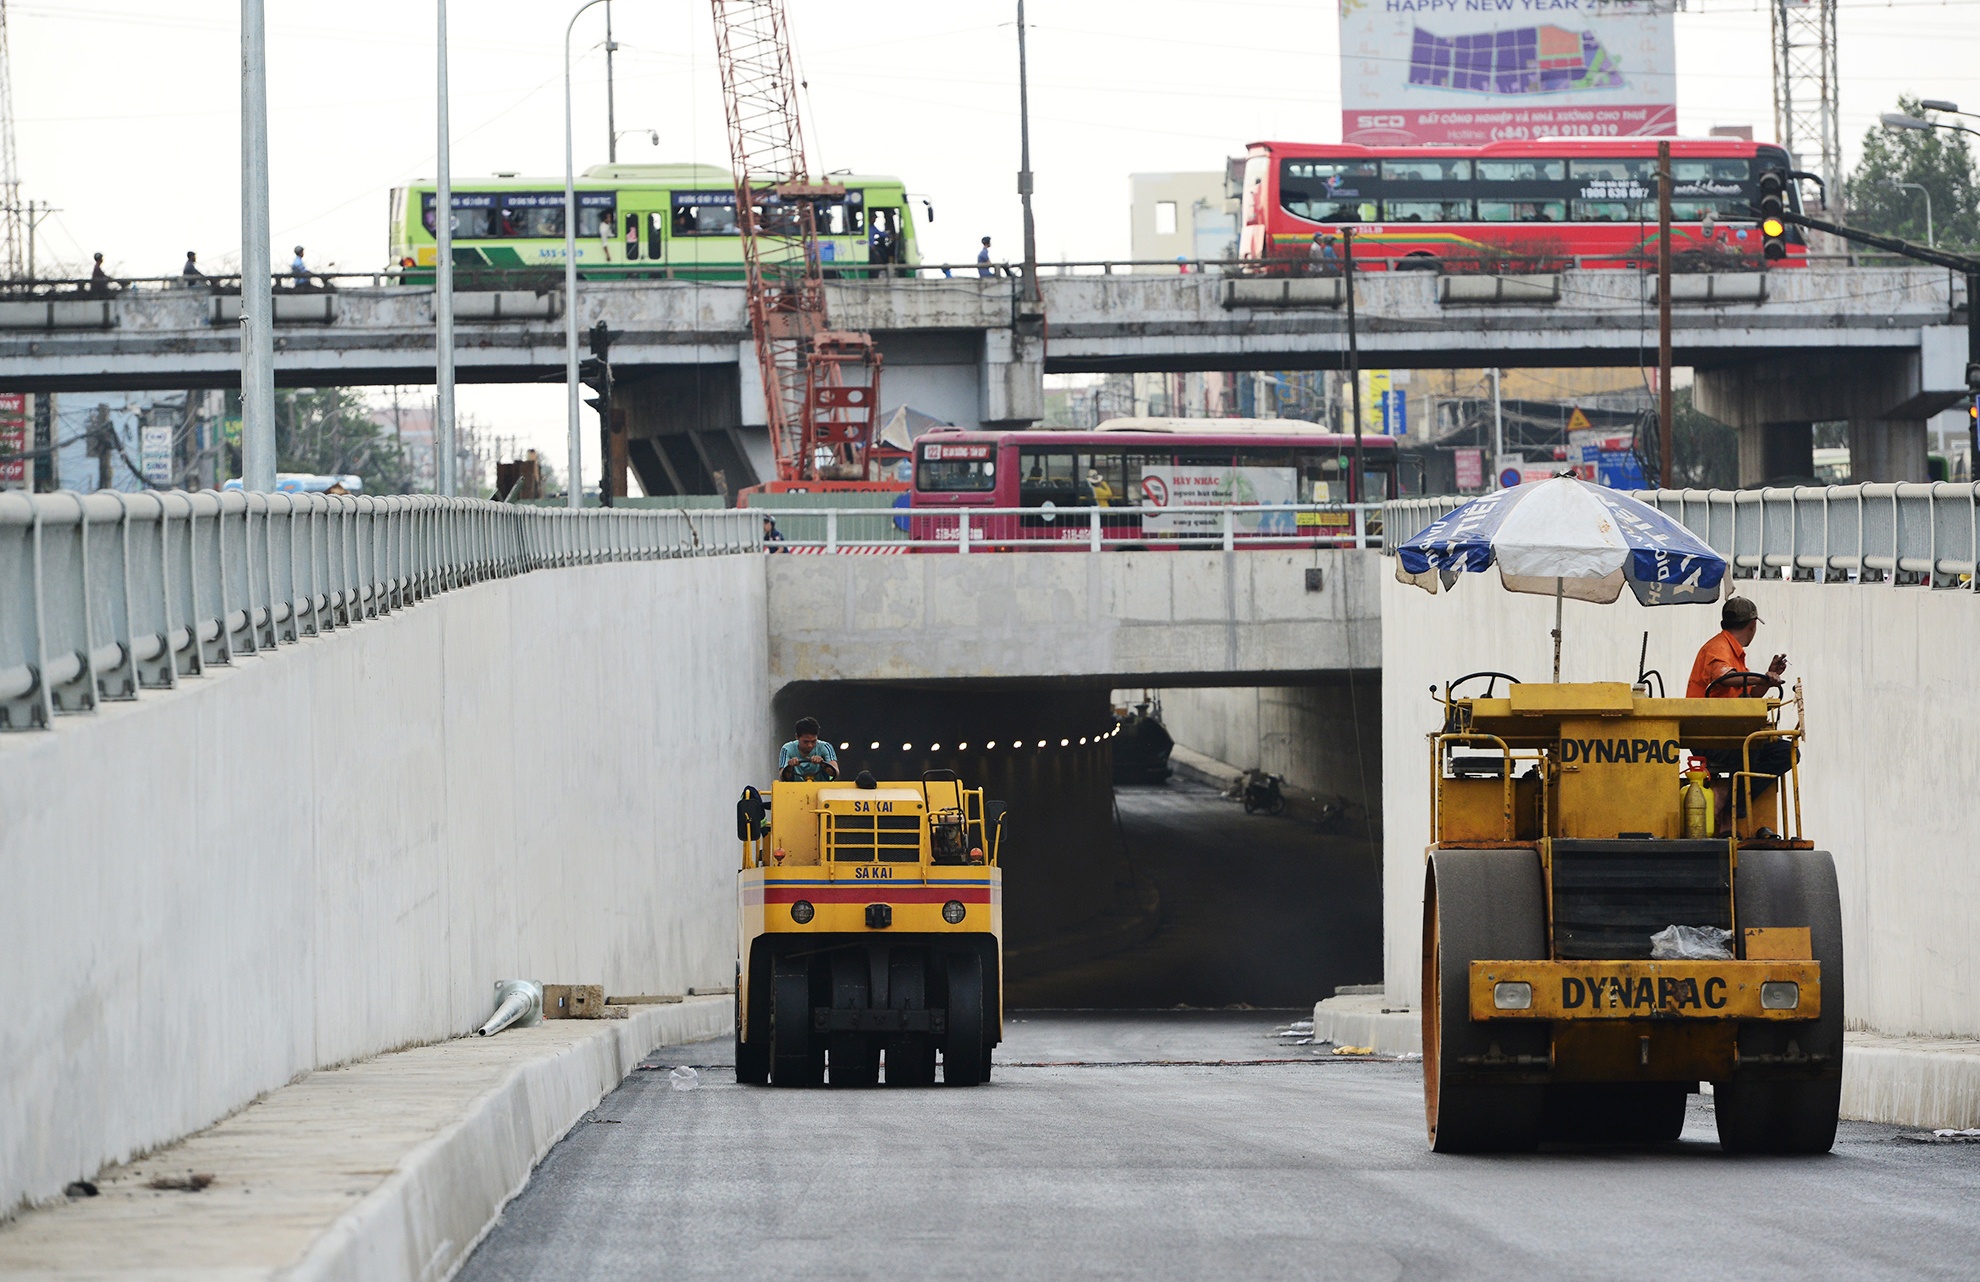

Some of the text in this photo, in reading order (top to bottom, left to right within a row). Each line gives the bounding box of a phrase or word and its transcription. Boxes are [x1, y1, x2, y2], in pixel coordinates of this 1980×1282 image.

[1387, 0, 1457, 12] HAPPY
[1465, 0, 1512, 11] NEW
[1522, 0, 1579, 10] YEAR
[1596, 110, 1621, 121] CHO
[1561, 738, 1680, 765] DYNAPAC
[855, 867, 893, 879] SAKAI
[1561, 976, 1728, 1010] DYNAPAC
